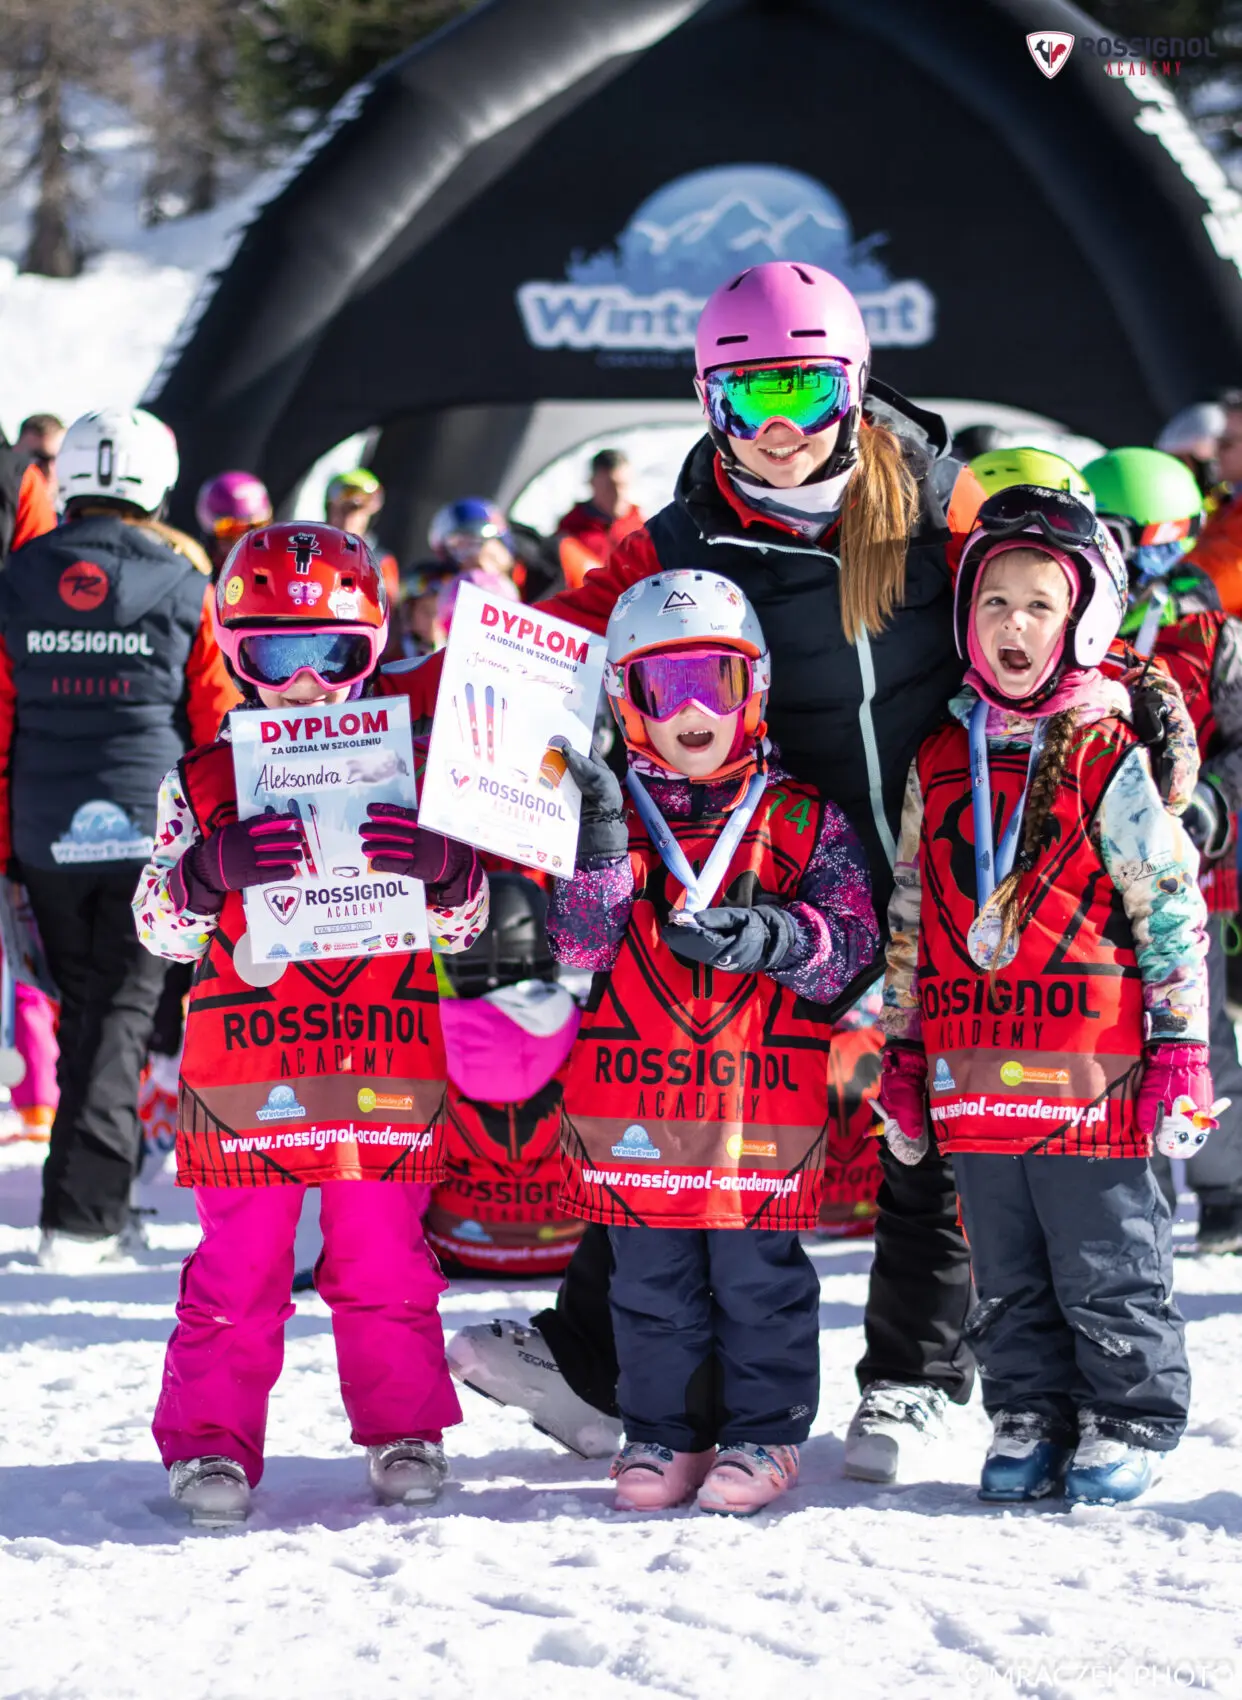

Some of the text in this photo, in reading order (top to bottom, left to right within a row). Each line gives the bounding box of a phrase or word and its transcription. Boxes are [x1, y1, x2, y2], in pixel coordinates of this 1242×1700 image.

[27, 631, 154, 656] ROSSIGNOL
[480, 603, 590, 665] DYPLOM
[485, 632, 496, 641] ZA
[526, 647, 535, 656] W
[535, 651, 578, 673] SZKOLENIU
[52, 677, 131, 696] ACADEMY
[261, 709, 389, 744] DYPLOM
[271, 747, 284, 756] ZA
[320, 743, 330, 751] W
[331, 737, 382, 750] SZKOLENIU
[254, 763, 342, 797] Aleksandra
[478, 776, 566, 822] ROSSIGNOL
[305, 880, 409, 906] ROSSIGNOL
[327, 902, 384, 919] ACADEMY
[223, 1002, 429, 1050] ROSSIGNOL
[939, 1019, 1044, 1048] ACADEMY
[280, 1045, 395, 1077] ACADEMY
[595, 1046, 799, 1091] ROSSIGNOL
[637, 1090, 760, 1121] ACADEMY
[221, 1124, 433, 1154] www.rossignol-academy.pl
[582, 1169, 801, 1199] www.rossignol-academy.pl
